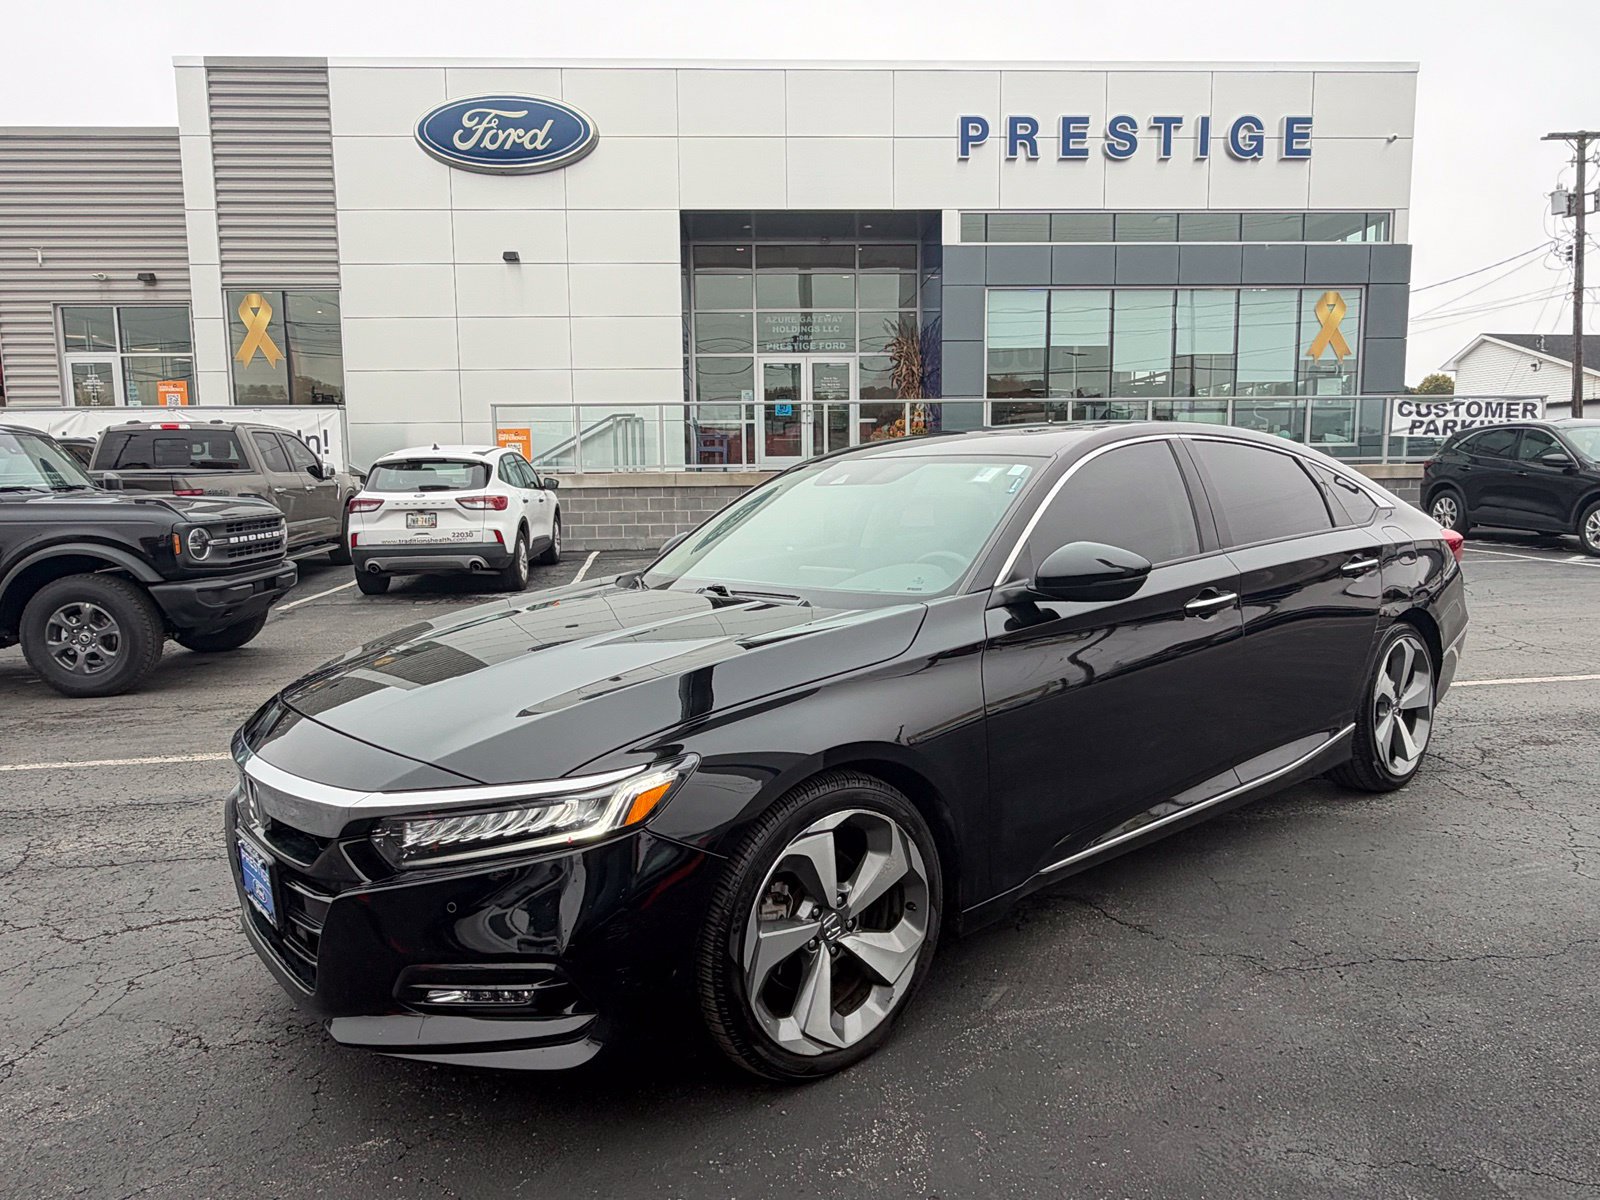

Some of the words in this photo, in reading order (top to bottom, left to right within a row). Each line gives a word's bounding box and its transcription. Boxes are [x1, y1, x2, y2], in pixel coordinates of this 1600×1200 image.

[453, 108, 553, 150] Ford
[957, 115, 1314, 160] PRESTIGE
[766, 315, 797, 324] AZURE
[800, 315, 844, 324] GATEWAY
[772, 325, 820, 333] HOLDINGS
[822, 325, 840, 333] LLC
[766, 342, 817, 350] PRESTIGE
[819, 342, 846, 350] FORD
[1397, 400, 1538, 419] CUSTOMER
[1408, 418, 1512, 436] PARK
[229, 531, 280, 544] BRONCO
